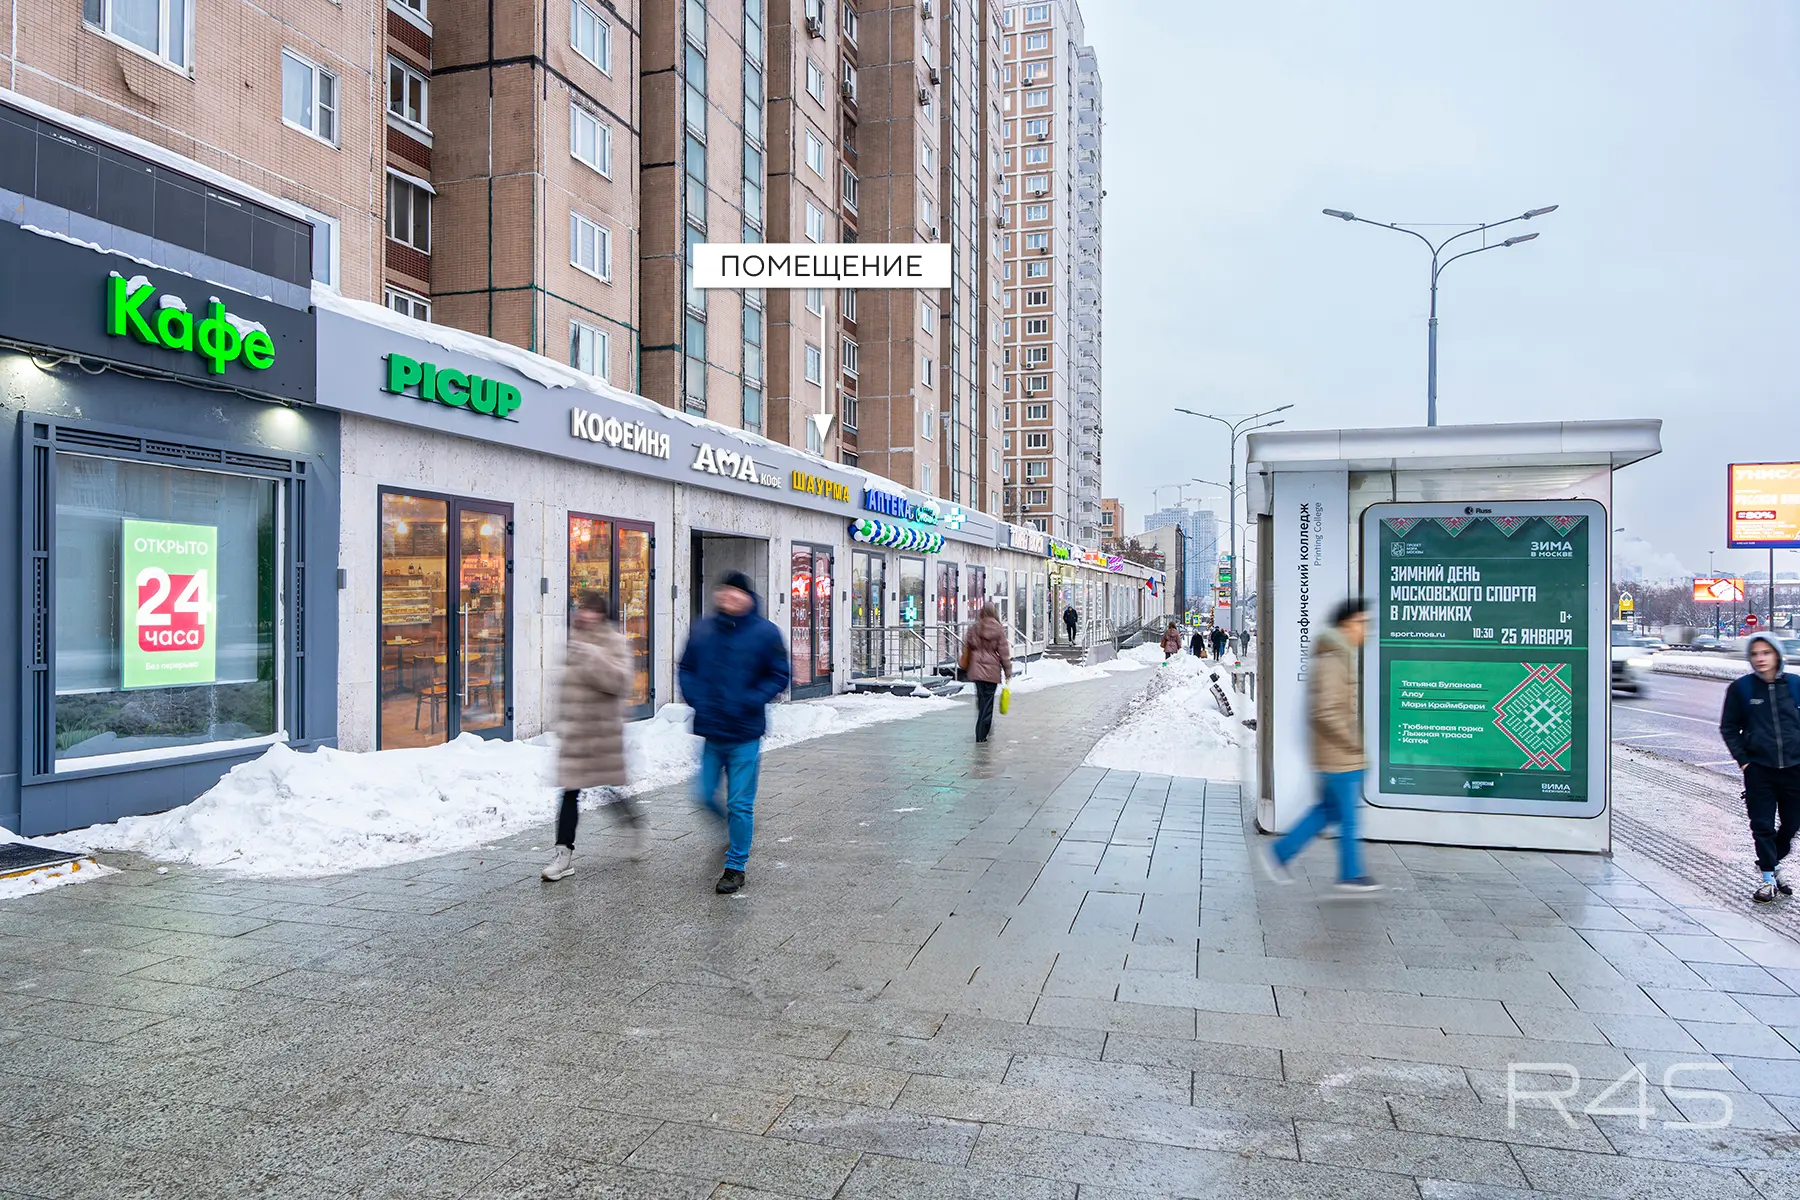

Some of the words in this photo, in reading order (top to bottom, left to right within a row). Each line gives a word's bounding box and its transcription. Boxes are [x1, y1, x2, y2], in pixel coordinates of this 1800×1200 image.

[107, 275, 276, 374] Кафе
[387, 352, 522, 419] PICUP
[571, 406, 670, 460] КОФЕЙНЯ
[760, 472, 782, 490] КОФЕ
[791, 470, 850, 503] ШАУРМА
[866, 488, 912, 519] АПТЕКА
[1314, 502, 1324, 533] College
[1299, 503, 1311, 560] колледж
[134, 537, 209, 555] ОТКРЫТО
[1314, 534, 1324, 567] Printing
[1531, 541, 1573, 551] ЗИМА
[1391, 564, 1444, 582] ЗИМНИЙ
[1447, 565, 1481, 584] ДЕНЬ
[135, 566, 213, 626] 24
[1390, 586, 1483, 602] МОСКОВСКОГО
[1486, 586, 1537, 603] СПОРТА
[1390, 606, 1399, 621] В
[1402, 605, 1473, 622] ЛУЖНИКАХ
[1560, 611, 1573, 624] 0+
[1297, 564, 1311, 682] Полиграфический
[145, 629, 200, 646] часа
[1390, 631, 1446, 639] sport.mos.ru
[1473, 628, 1494, 639] 10:30
[1501, 628, 1517, 645] 25
[1521, 628, 1573, 645] ЯНВАРЯ
[145, 662, 160, 671] Без
[1401, 680, 1437, 688] Татьяна
[1438, 681, 1483, 689] Буланова
[1401, 690, 1424, 699] Алсу
[1401, 701, 1427, 709] Мари
[1428, 701, 1486, 710] Краймбрери
[1402, 723, 1457, 731] Тюбинговая
[1402, 730, 1440, 738] Лыжная
